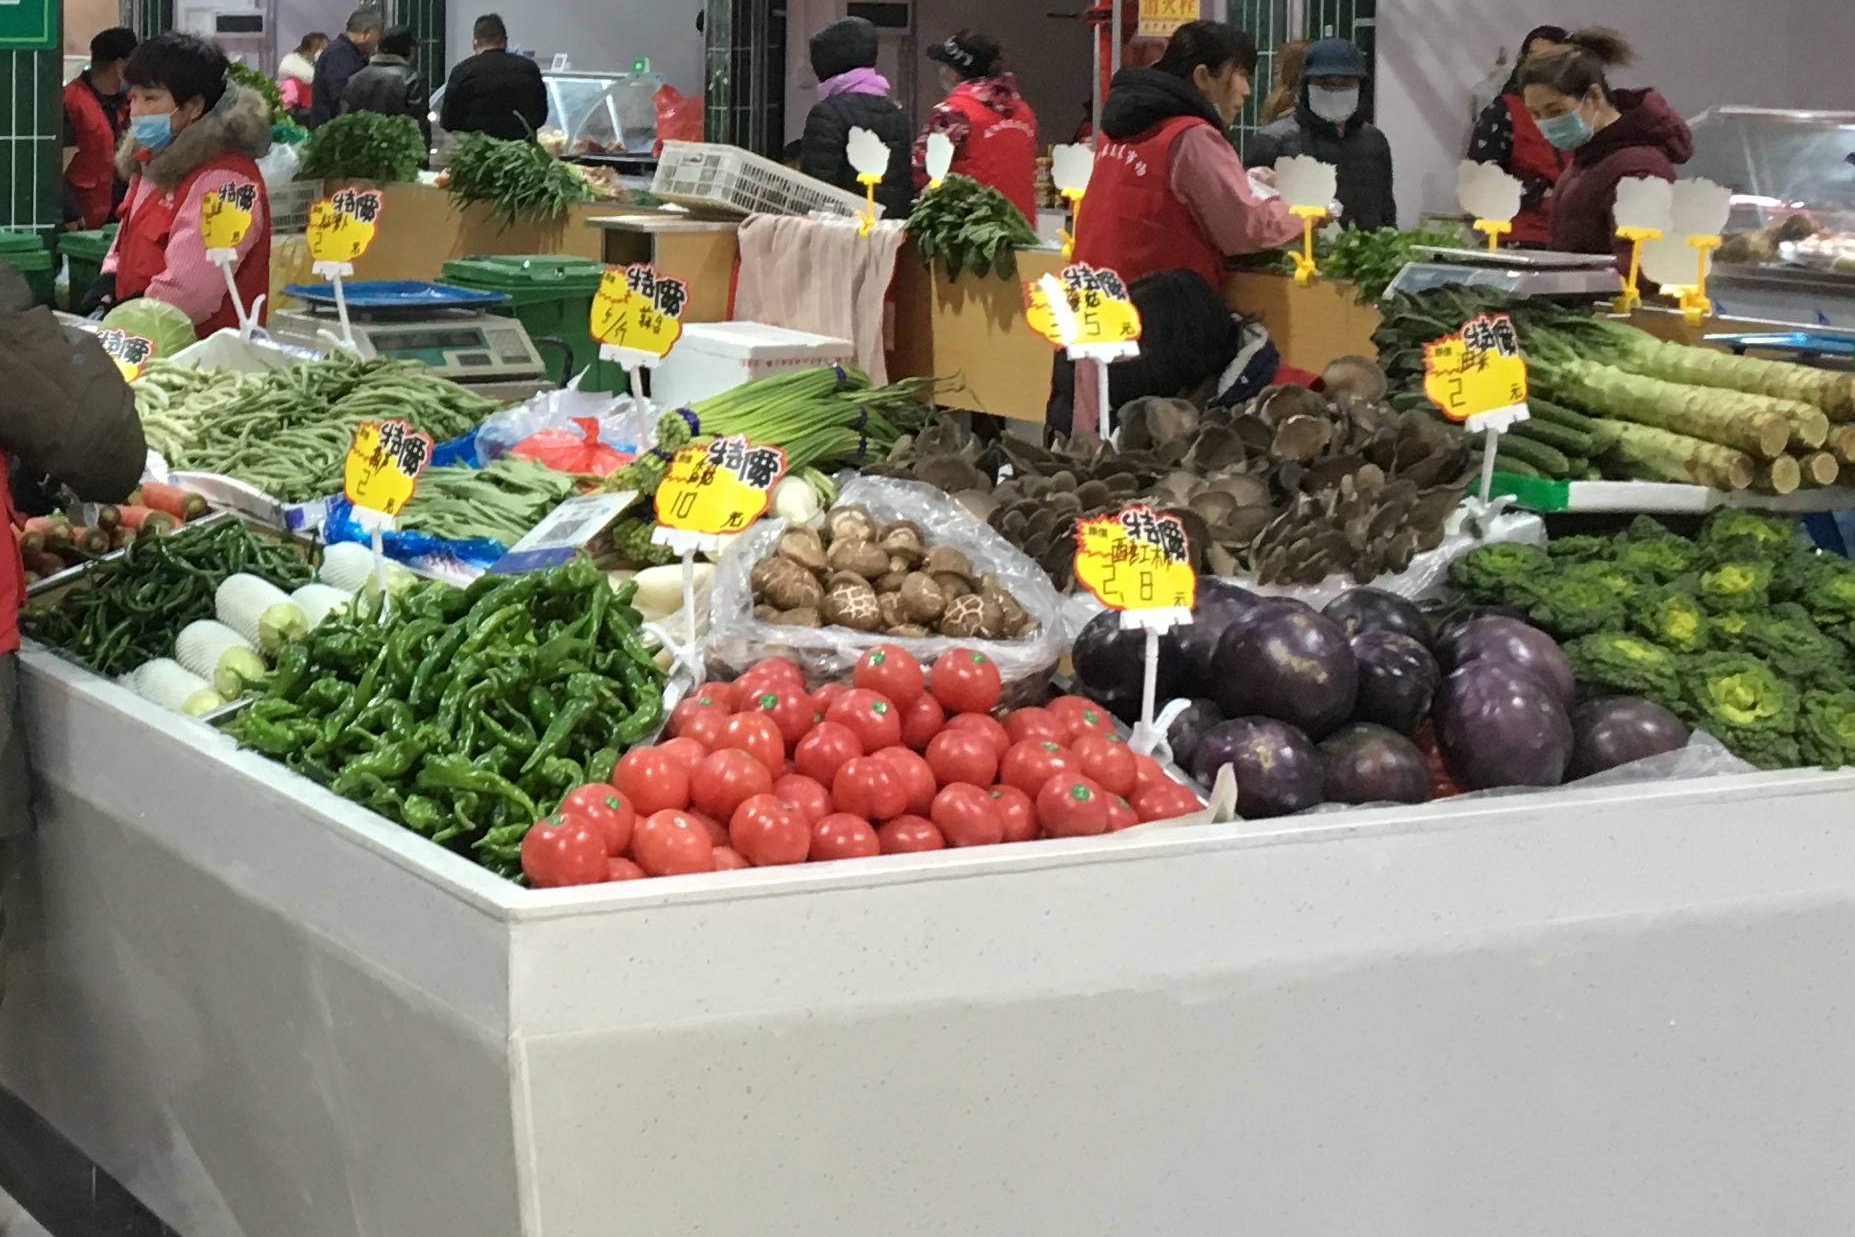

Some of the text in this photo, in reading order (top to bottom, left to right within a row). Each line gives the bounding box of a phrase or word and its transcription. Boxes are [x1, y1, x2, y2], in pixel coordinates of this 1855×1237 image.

[1084, 311, 1102, 336] 5
[1448, 377, 1524, 408] 2 元
[669, 490, 698, 520] 10
